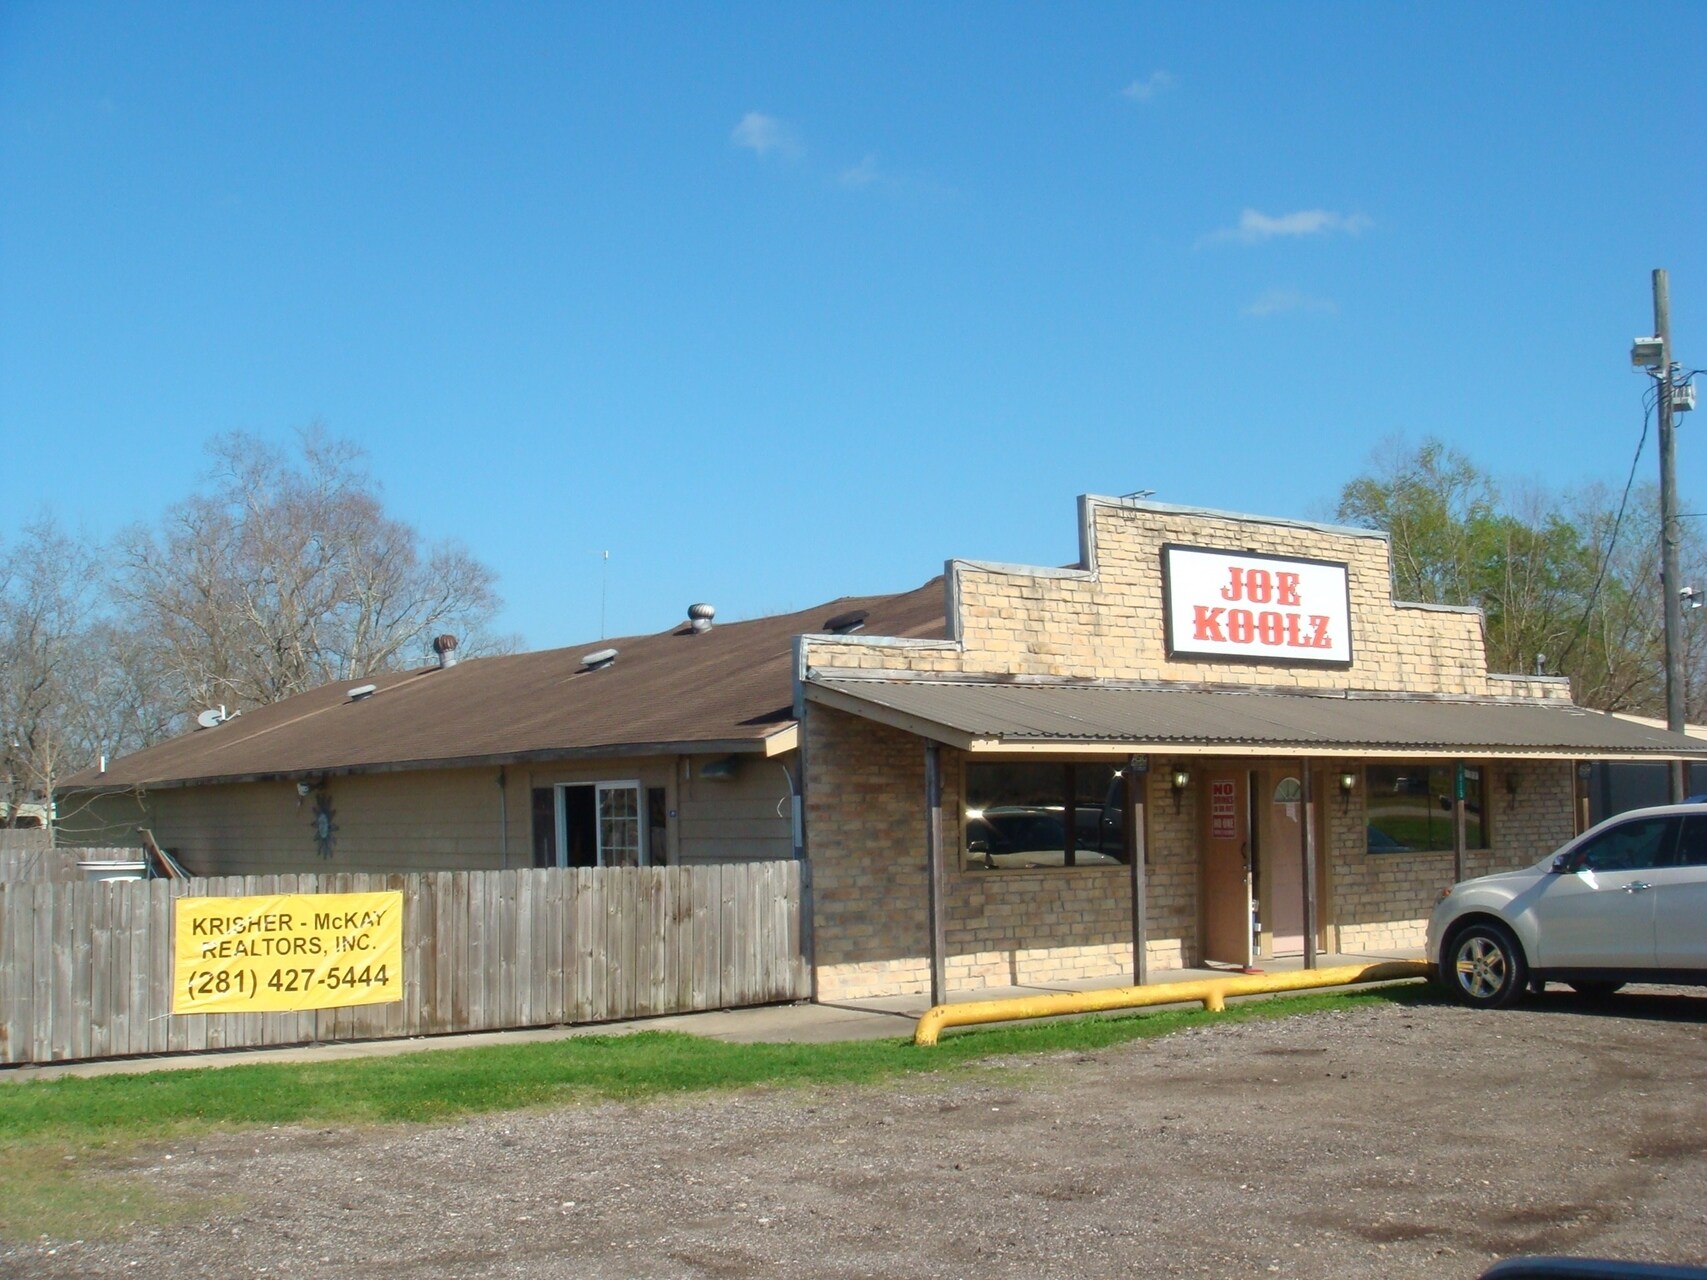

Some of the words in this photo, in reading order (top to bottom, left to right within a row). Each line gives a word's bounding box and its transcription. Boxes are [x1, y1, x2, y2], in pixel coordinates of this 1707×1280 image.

[1220, 567, 1301, 606] JOE
[1193, 605, 1332, 649] KOOLZ
[1213, 784, 1233, 795] NO
[193, 914, 293, 935] KRISHER
[314, 910, 387, 930] McKAY
[202, 937, 327, 959] REALTORS,
[336, 934, 376, 953] INC.
[188, 969, 257, 1000] (281)
[267, 964, 389, 992] 427-5444
